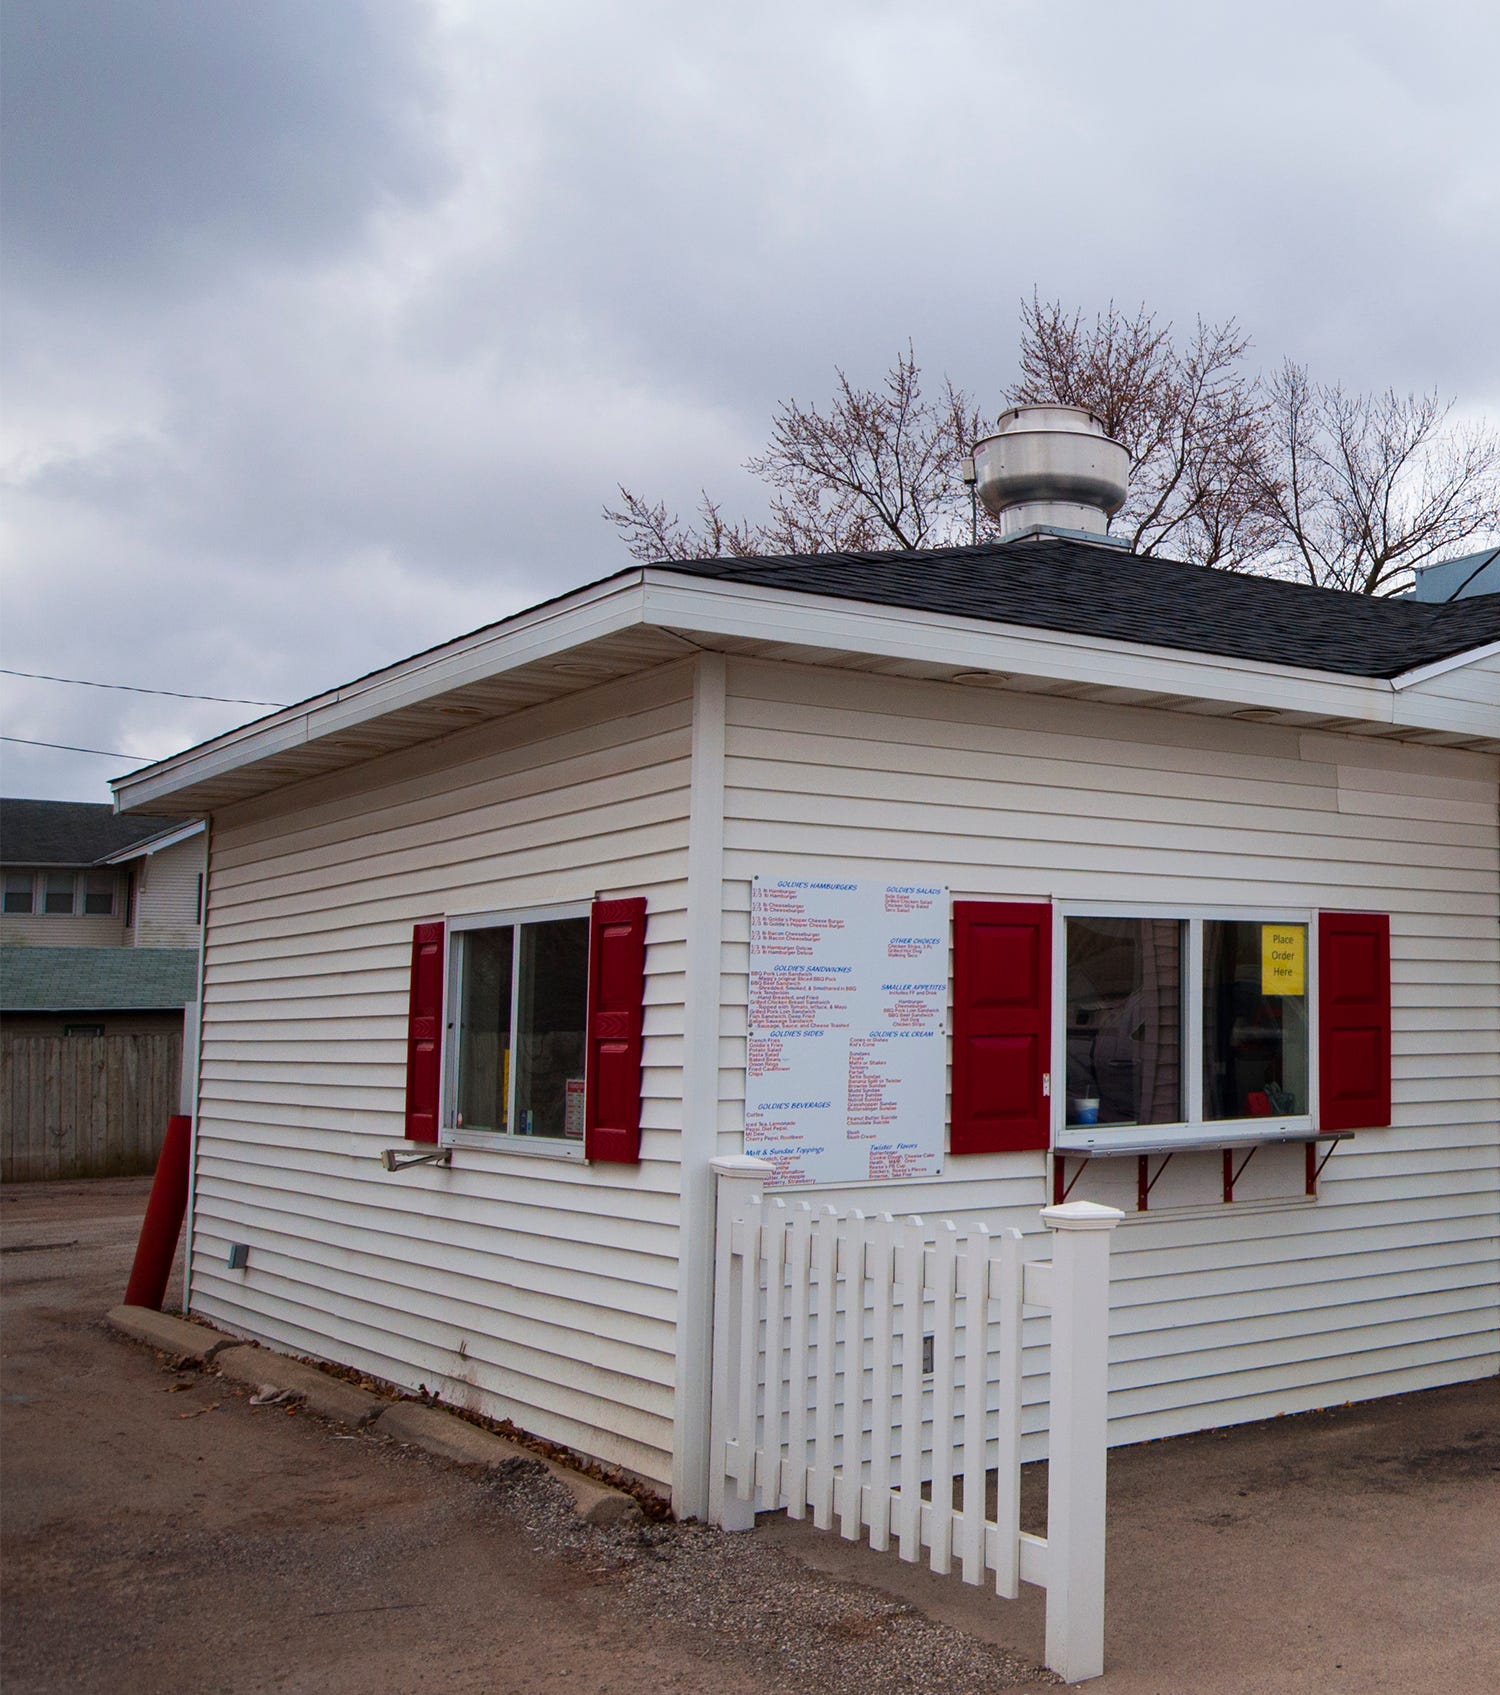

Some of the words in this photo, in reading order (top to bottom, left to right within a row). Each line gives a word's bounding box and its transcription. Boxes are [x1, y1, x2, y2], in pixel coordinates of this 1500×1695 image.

[810, 882, 858, 890] HAMBURGERS
[1272, 934, 1294, 944] Place
[1271, 951, 1295, 960] Order
[1273, 968, 1293, 976] Here
[758, 1102, 790, 1110] GOLDIE'S
[791, 1101, 831, 1109] BEVERAGES
